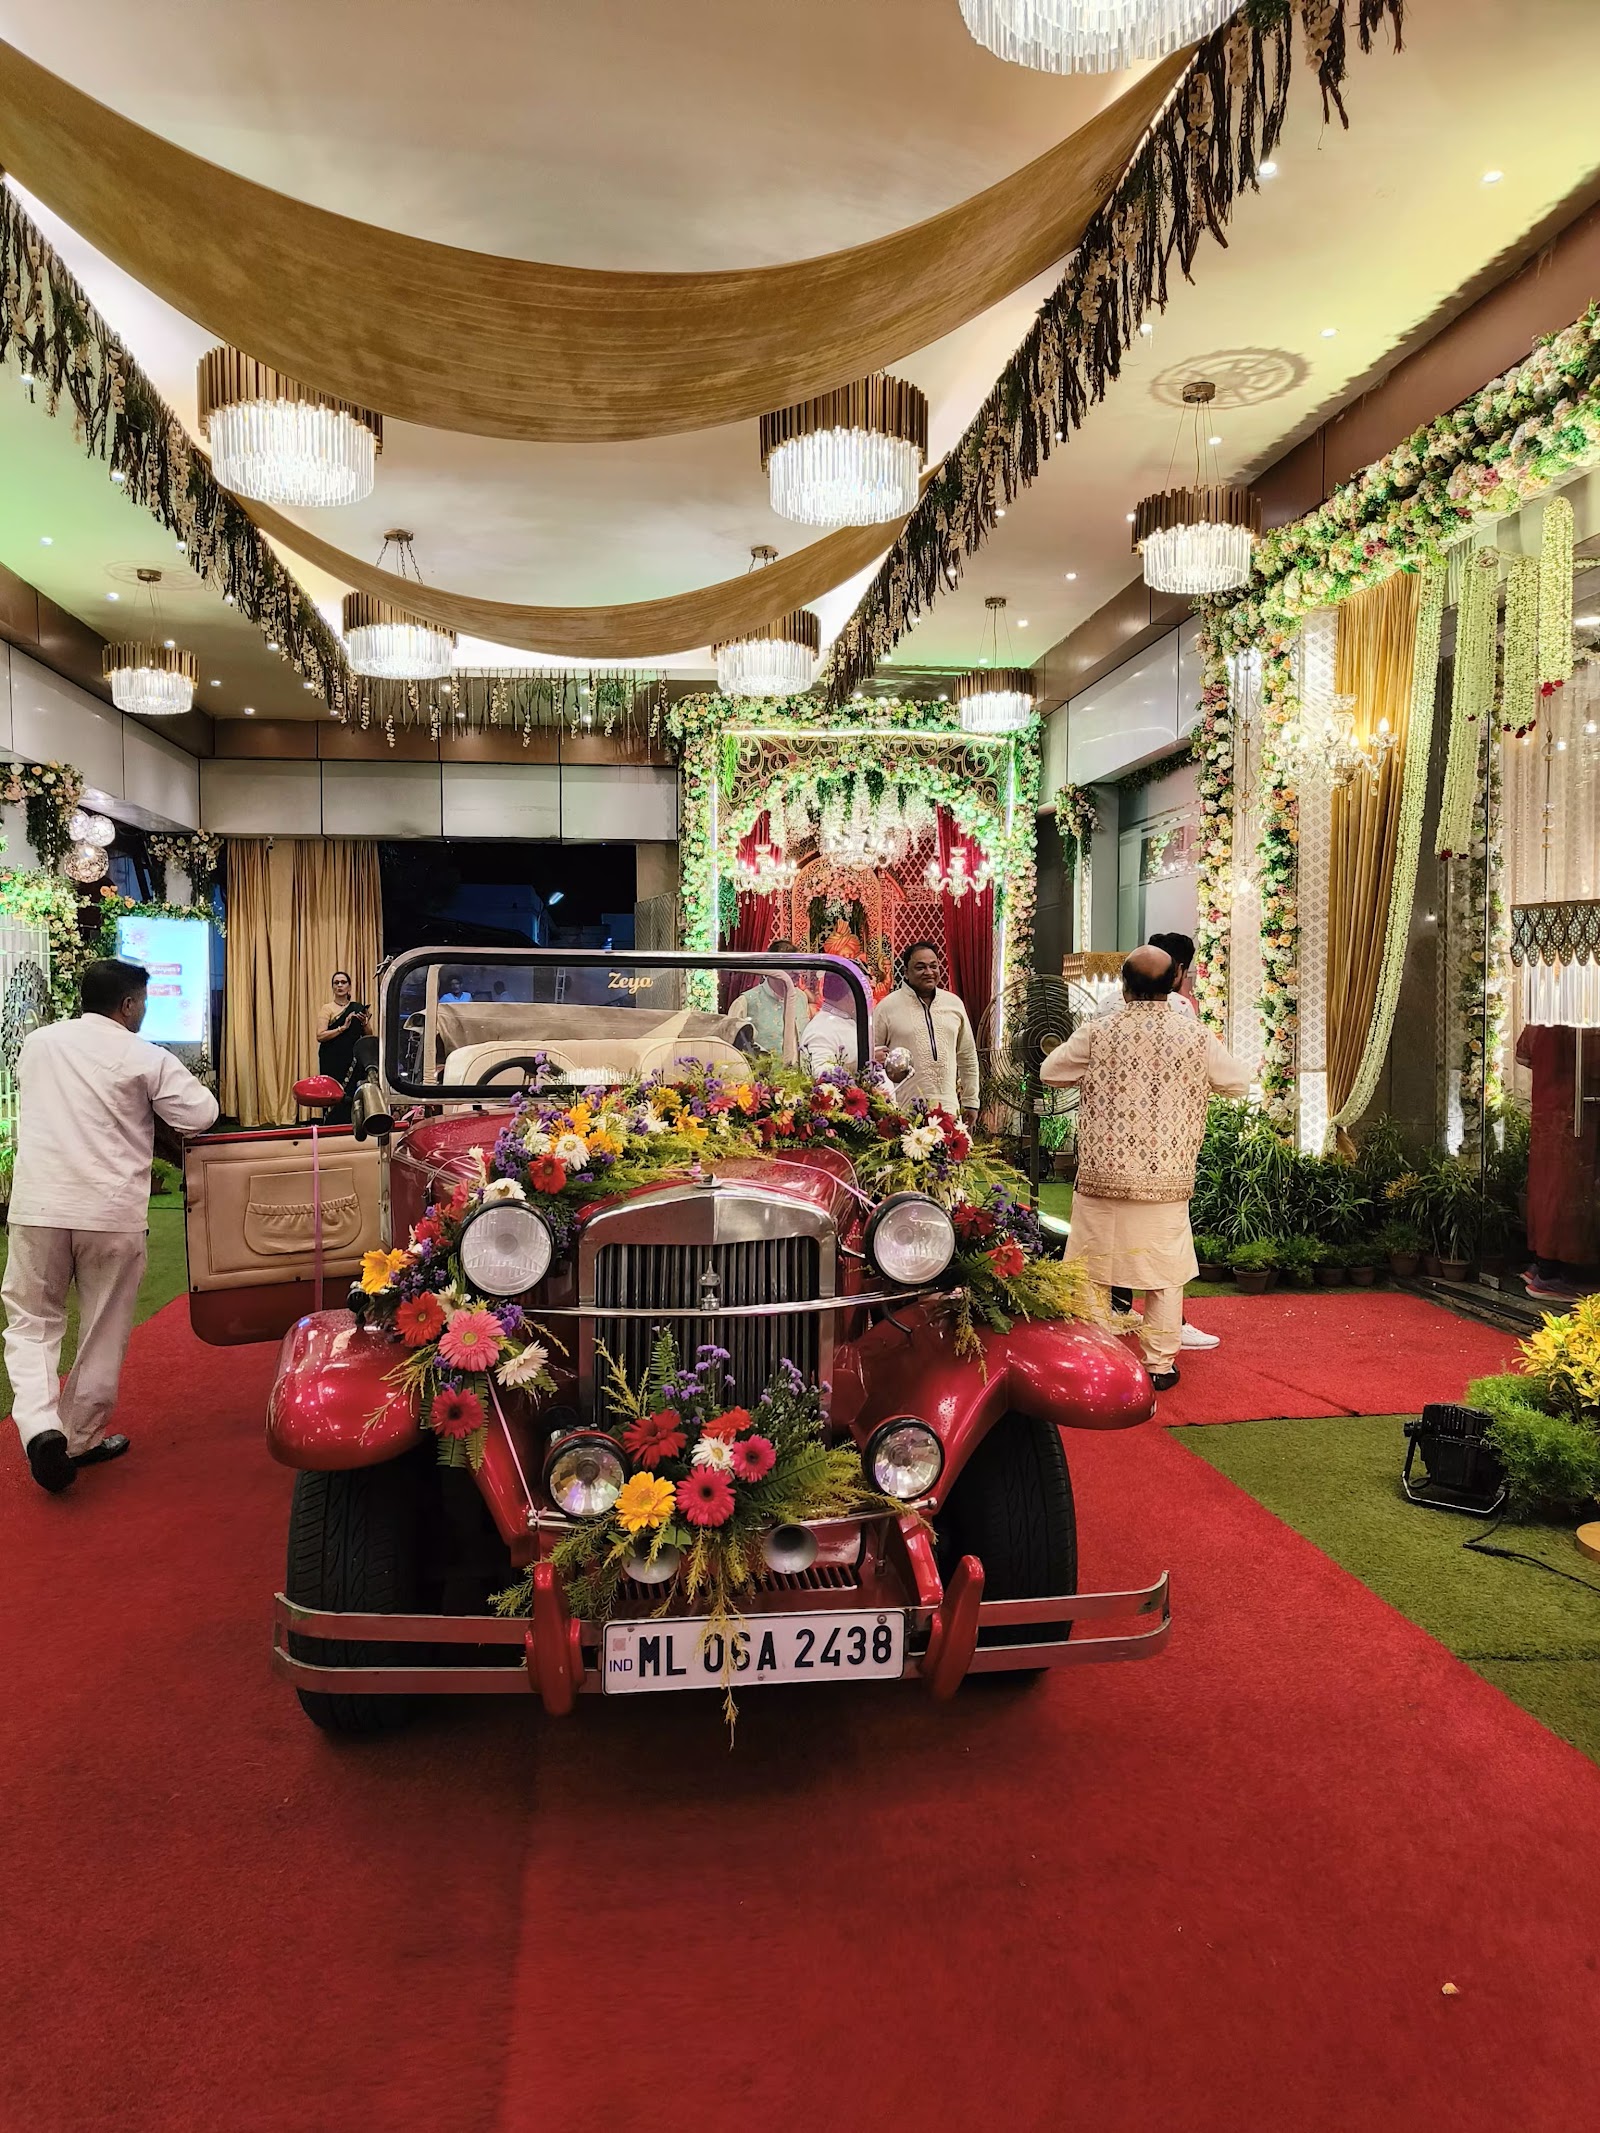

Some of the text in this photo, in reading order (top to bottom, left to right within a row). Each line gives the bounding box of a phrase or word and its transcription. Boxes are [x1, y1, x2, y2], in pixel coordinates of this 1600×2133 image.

[608, 972, 653, 994] Zeya
[638, 1635, 687, 1678] ML
[794, 1624, 892, 1669] 2438
[609, 1658, 633, 1673] IND
